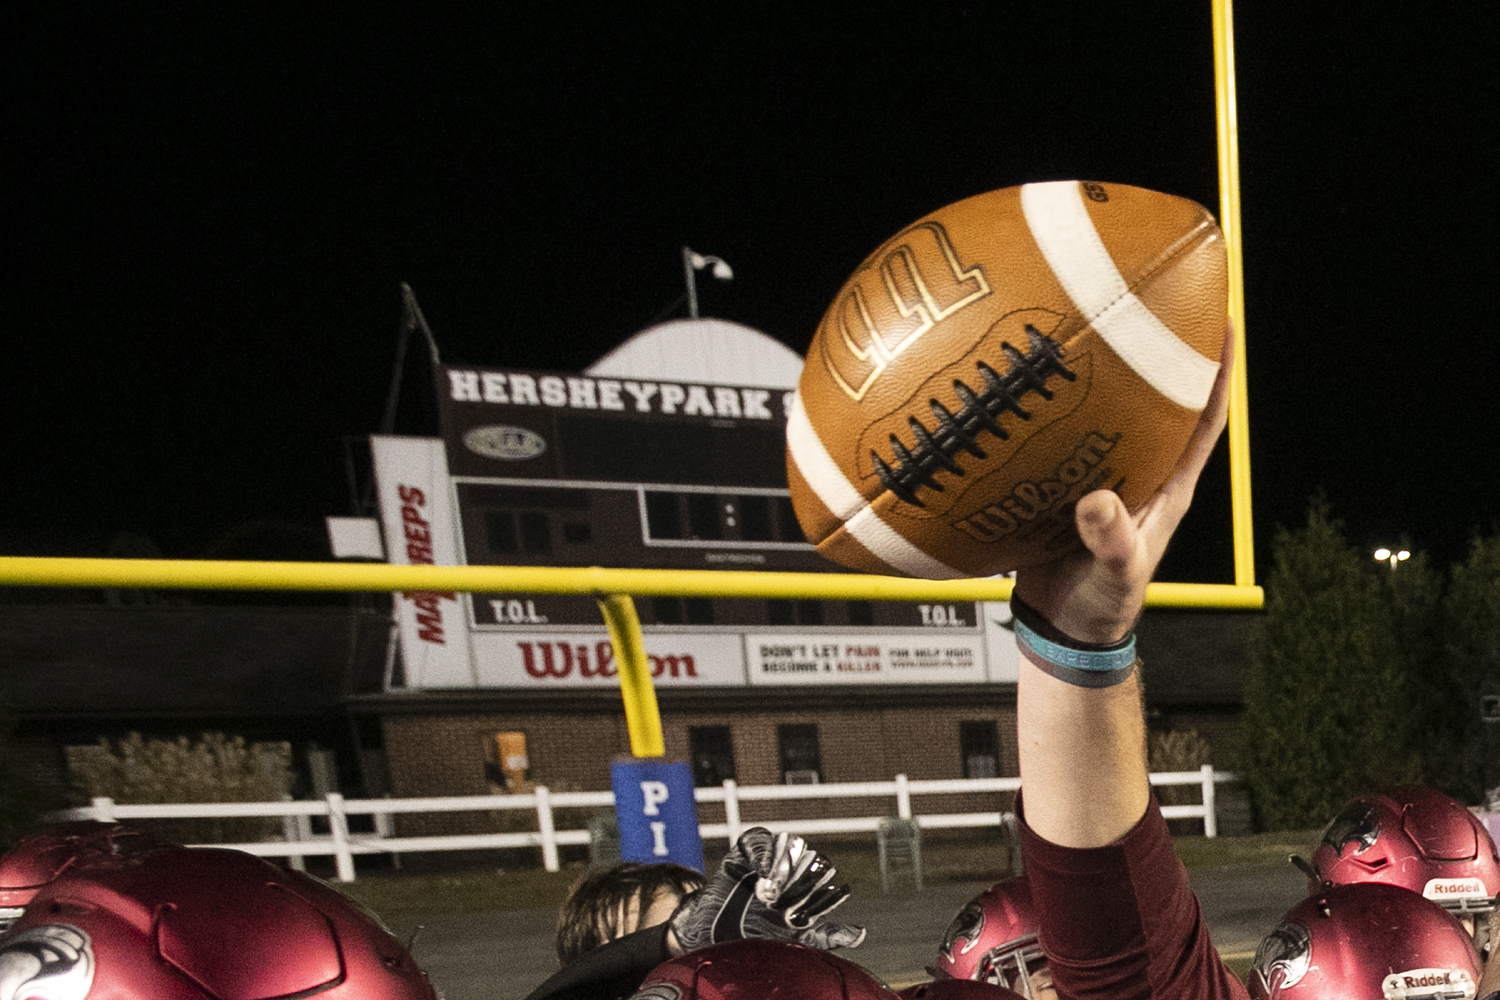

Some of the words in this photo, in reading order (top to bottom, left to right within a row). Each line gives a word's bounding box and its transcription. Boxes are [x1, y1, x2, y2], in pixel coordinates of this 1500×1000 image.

[448, 369, 772, 420] HERSHEYPARK
[951, 431, 1122, 543] Wilson
[398, 484, 456, 644] MAREPS
[517, 641, 698, 678] Wilon
[813, 646, 839, 658] LET
[1434, 883, 1480, 893] Riddell
